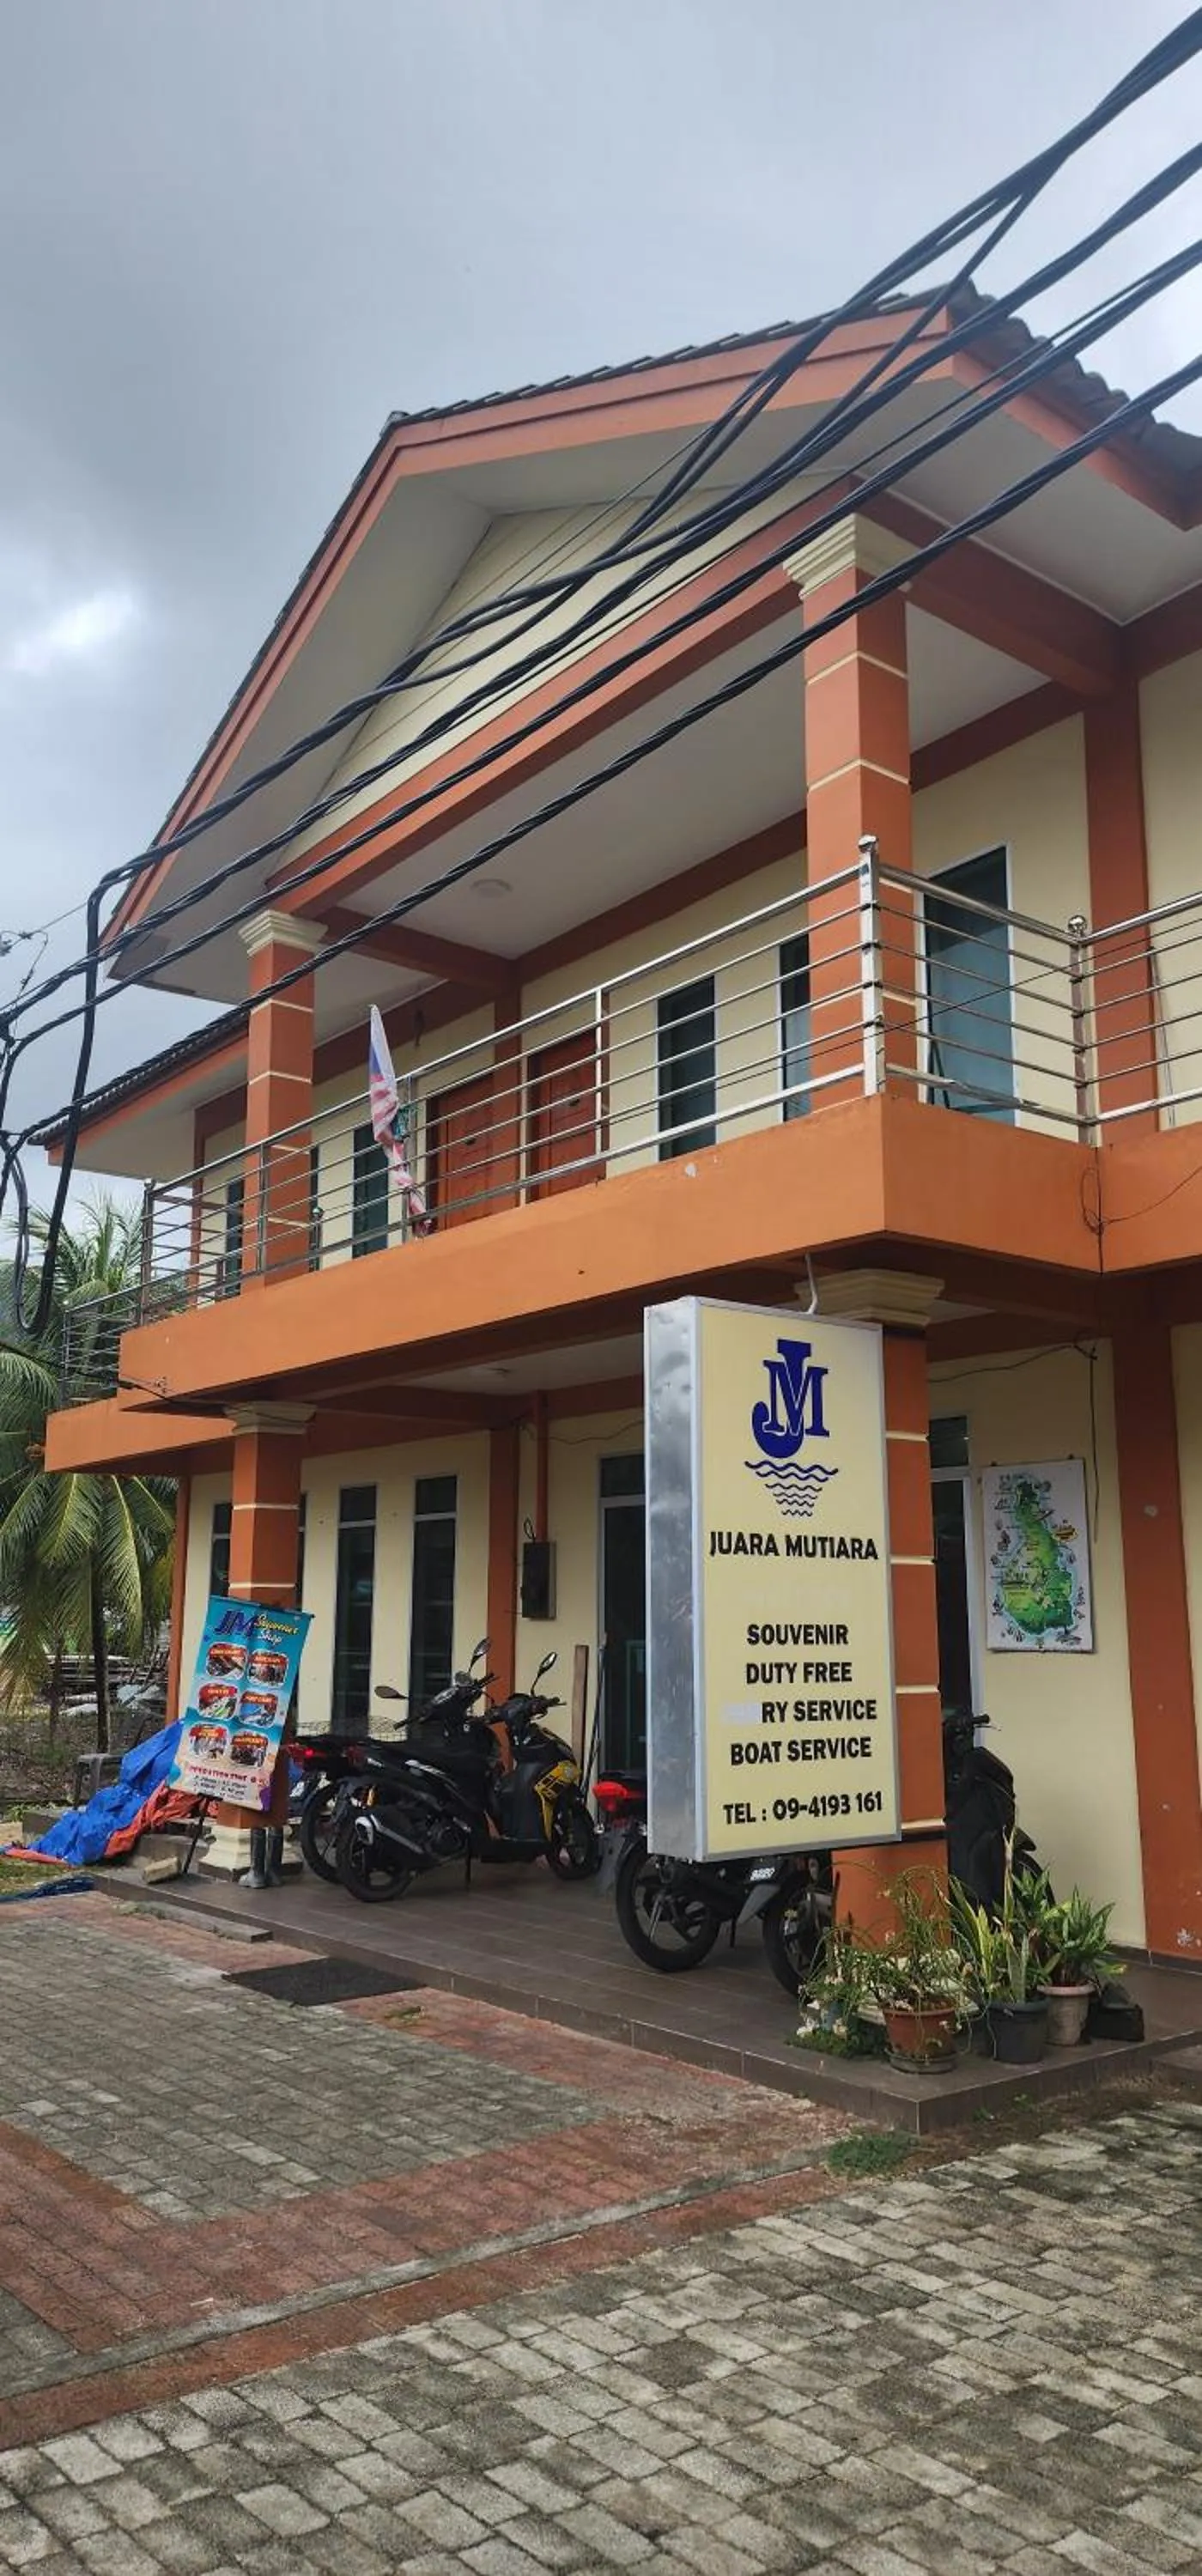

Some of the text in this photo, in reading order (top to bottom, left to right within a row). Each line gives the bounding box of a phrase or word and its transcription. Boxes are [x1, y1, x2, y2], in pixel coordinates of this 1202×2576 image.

[710, 1532, 878, 1559] JUARA MUTIARA
[747, 1625, 848, 1645] SOUVENIR
[747, 1662, 852, 1684] DUTY FREE
[793, 1699, 877, 1722] SERVICE
[732, 1736, 871, 1765] BOAT SERVICE
[773, 1795, 850, 1820] 09-4193
[856, 1791, 882, 1813] 161
